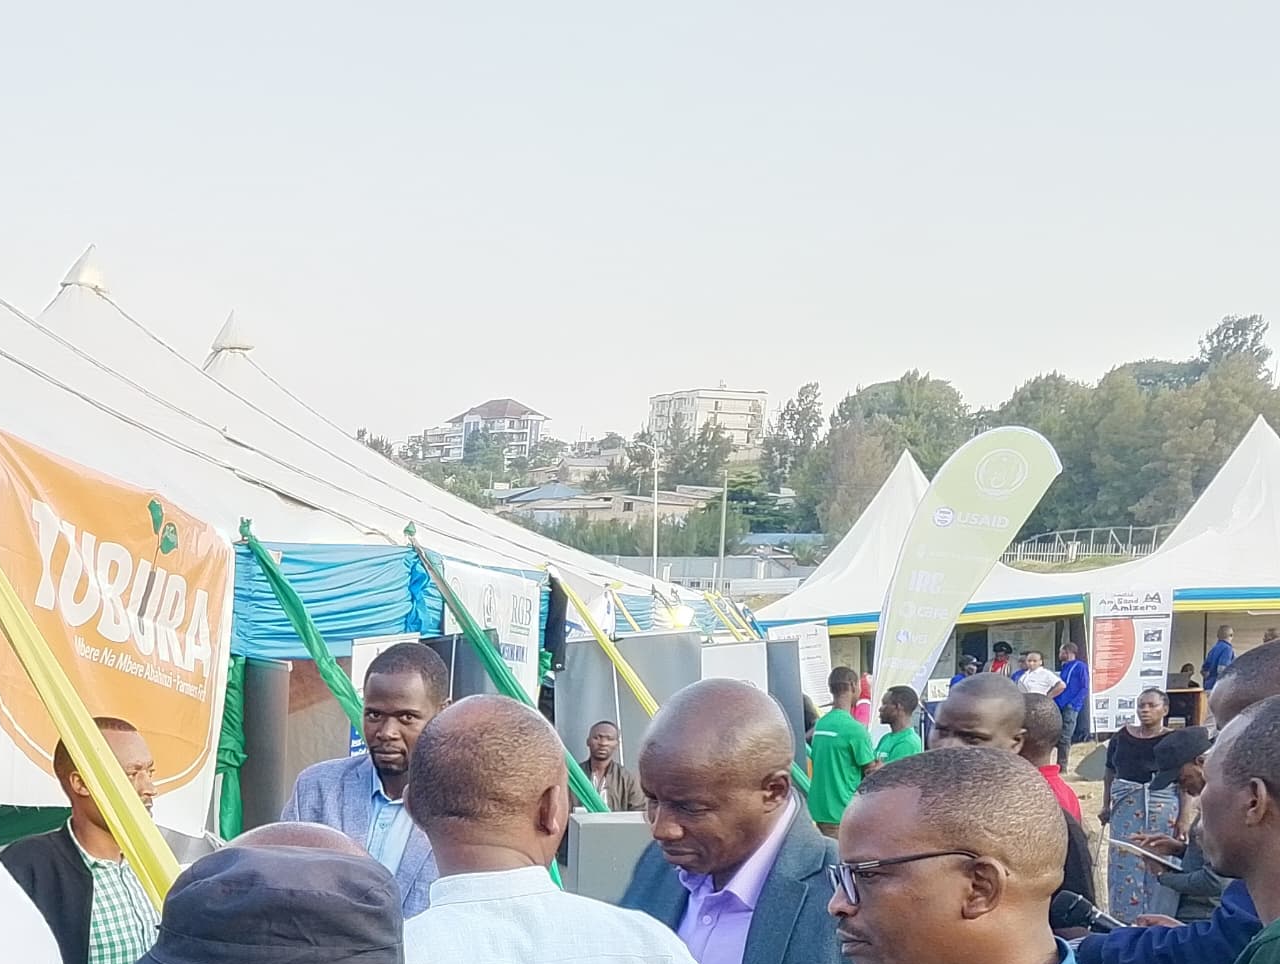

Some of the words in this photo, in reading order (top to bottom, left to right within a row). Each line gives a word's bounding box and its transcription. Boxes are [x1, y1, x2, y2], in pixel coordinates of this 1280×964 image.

[956, 512, 1010, 529] USAID
[31, 499, 212, 677] TUBURA
[511, 594, 533, 627] RGB
[99, 647, 116, 667] Na
[116, 652, 145, 677] Mbere
